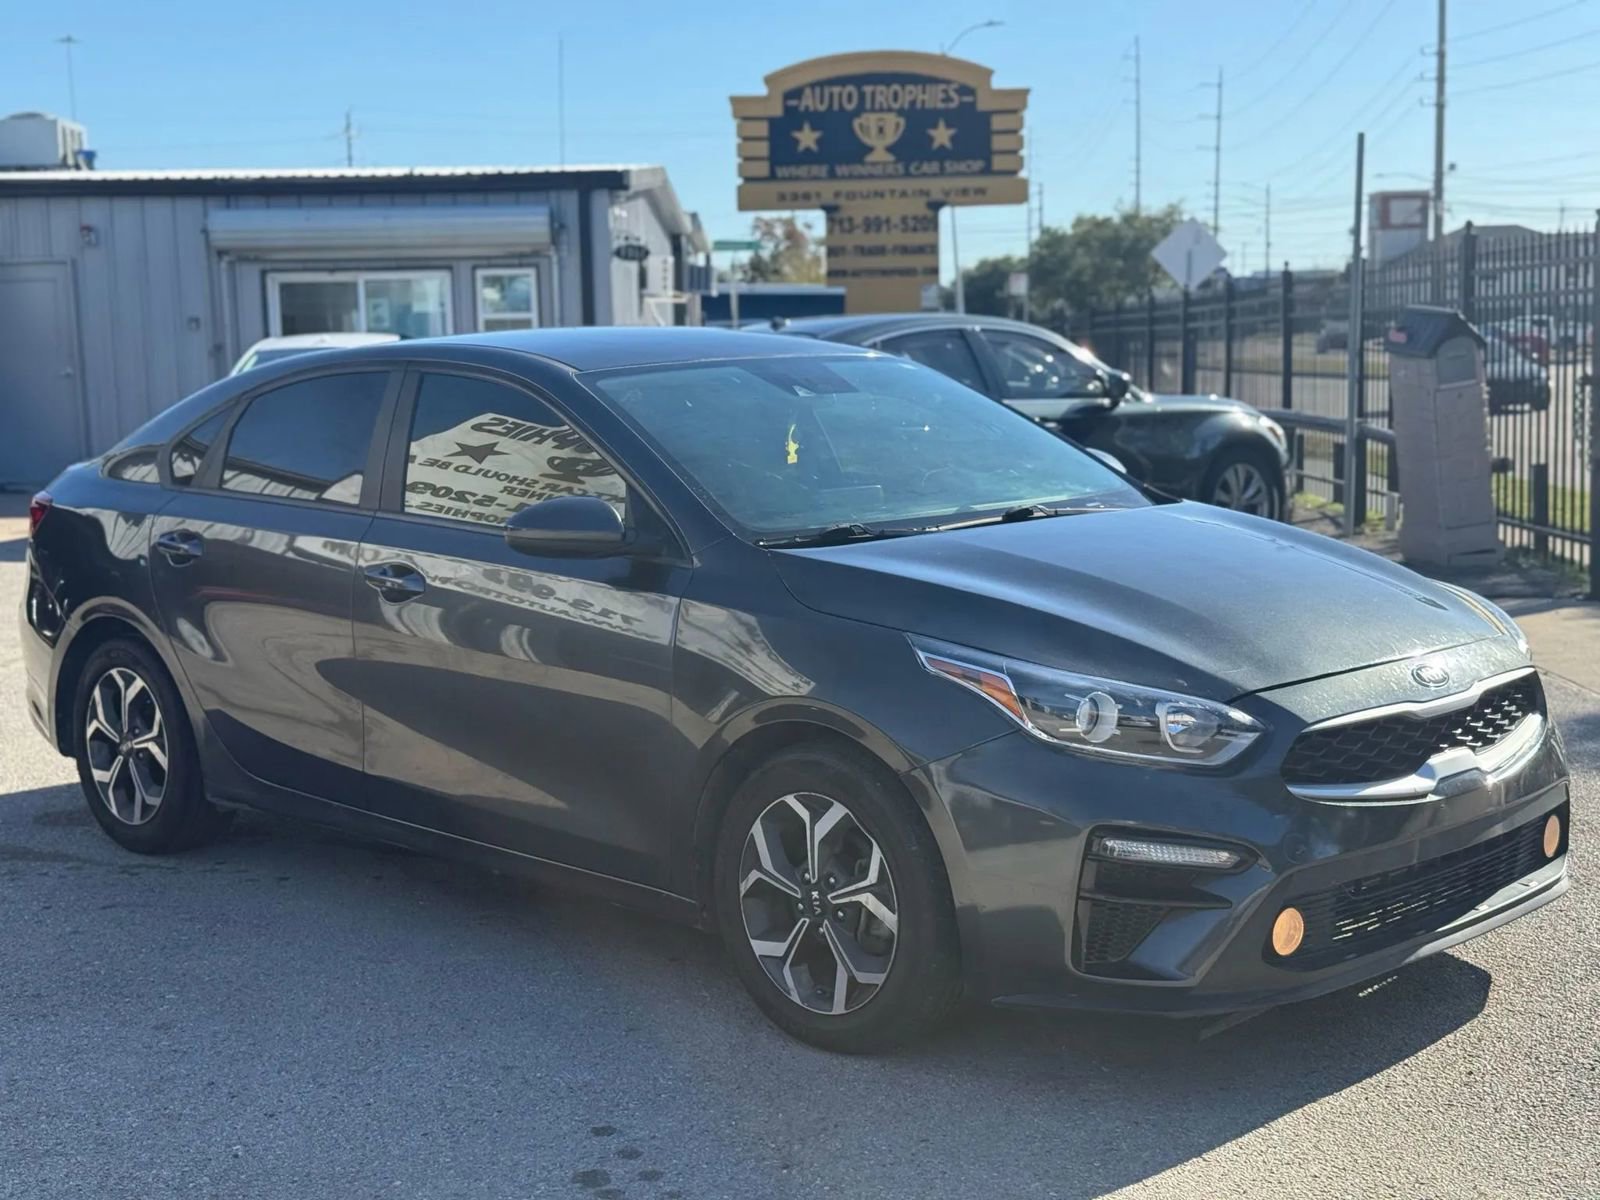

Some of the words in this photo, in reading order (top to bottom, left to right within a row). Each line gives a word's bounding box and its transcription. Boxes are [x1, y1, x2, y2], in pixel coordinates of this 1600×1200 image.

[799, 86, 859, 112] AUTO
[862, 84, 960, 111] TROPHIES
[775, 164, 829, 179] WHERE
[909, 161, 940, 175] CAR
[942, 160, 986, 174] SHOP
[833, 187, 931, 201] FOUNTAIN
[941, 186, 989, 199] VIEW
[811, 890, 822, 916] KIA
